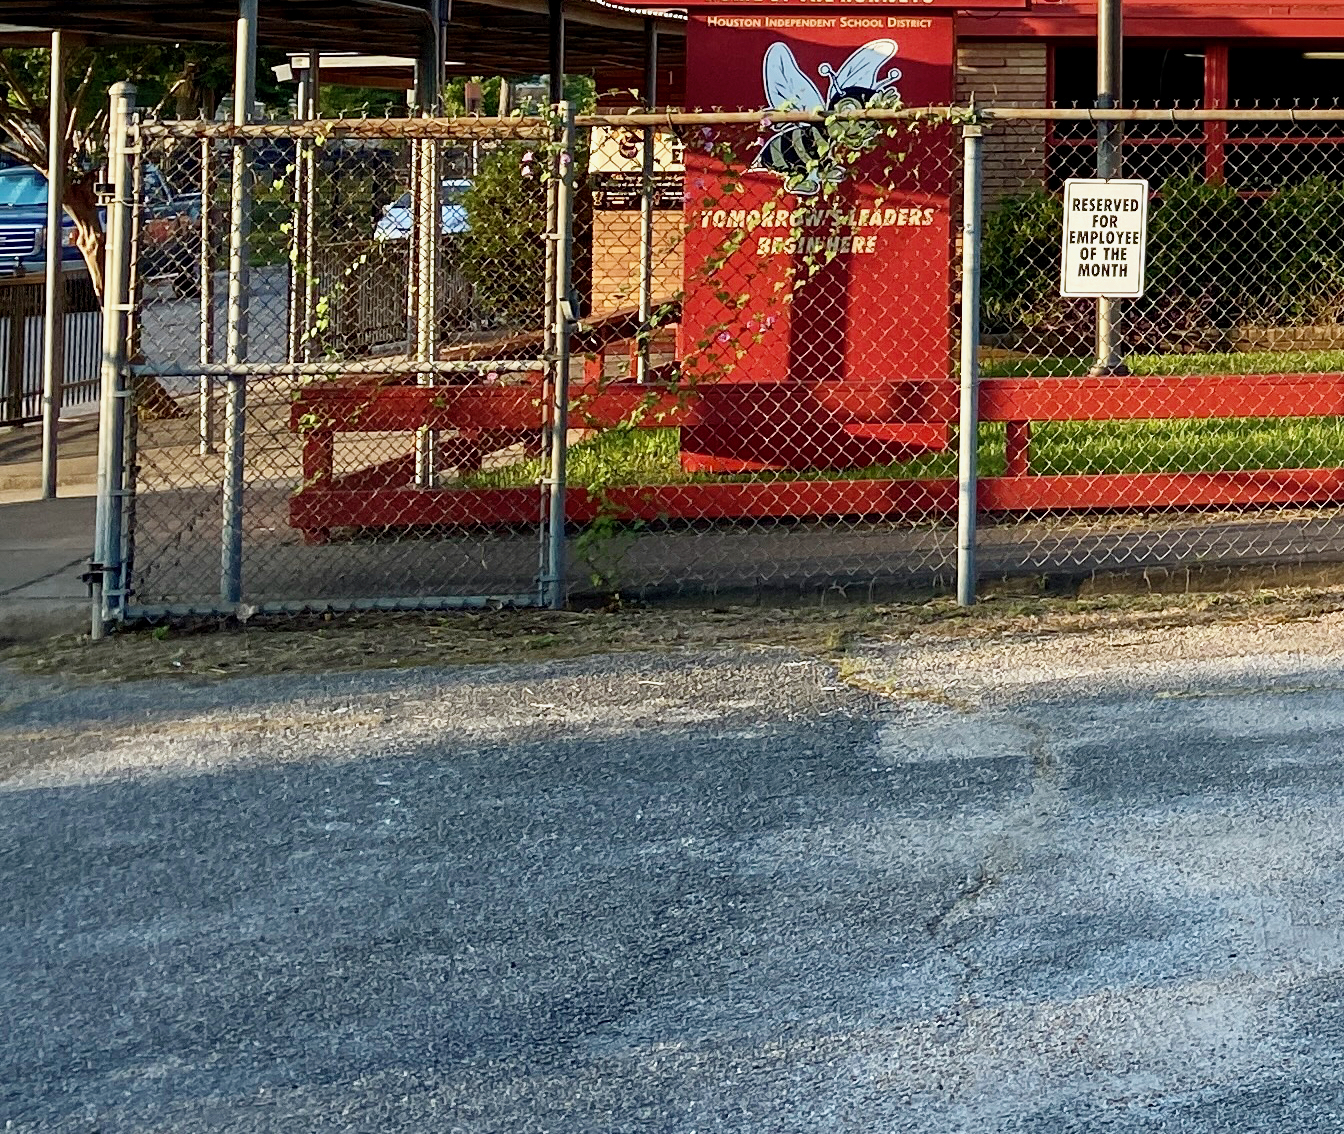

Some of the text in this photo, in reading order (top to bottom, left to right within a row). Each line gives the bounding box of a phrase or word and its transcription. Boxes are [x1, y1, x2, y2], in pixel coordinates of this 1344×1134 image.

[707, 16, 932, 28] HOUSTON INDEPENDENT SCHOOL DISTRICT
[1072, 198, 1139, 212] RESERVED
[847, 208, 935, 226] LEADERS
[1092, 214, 1118, 228] FOR
[1069, 230, 1139, 244] EMPLOYEE
[757, 235, 877, 255] BEGIN HERE
[1080, 247, 1127, 261] OF THE
[1078, 263, 1128, 277] MONTH
